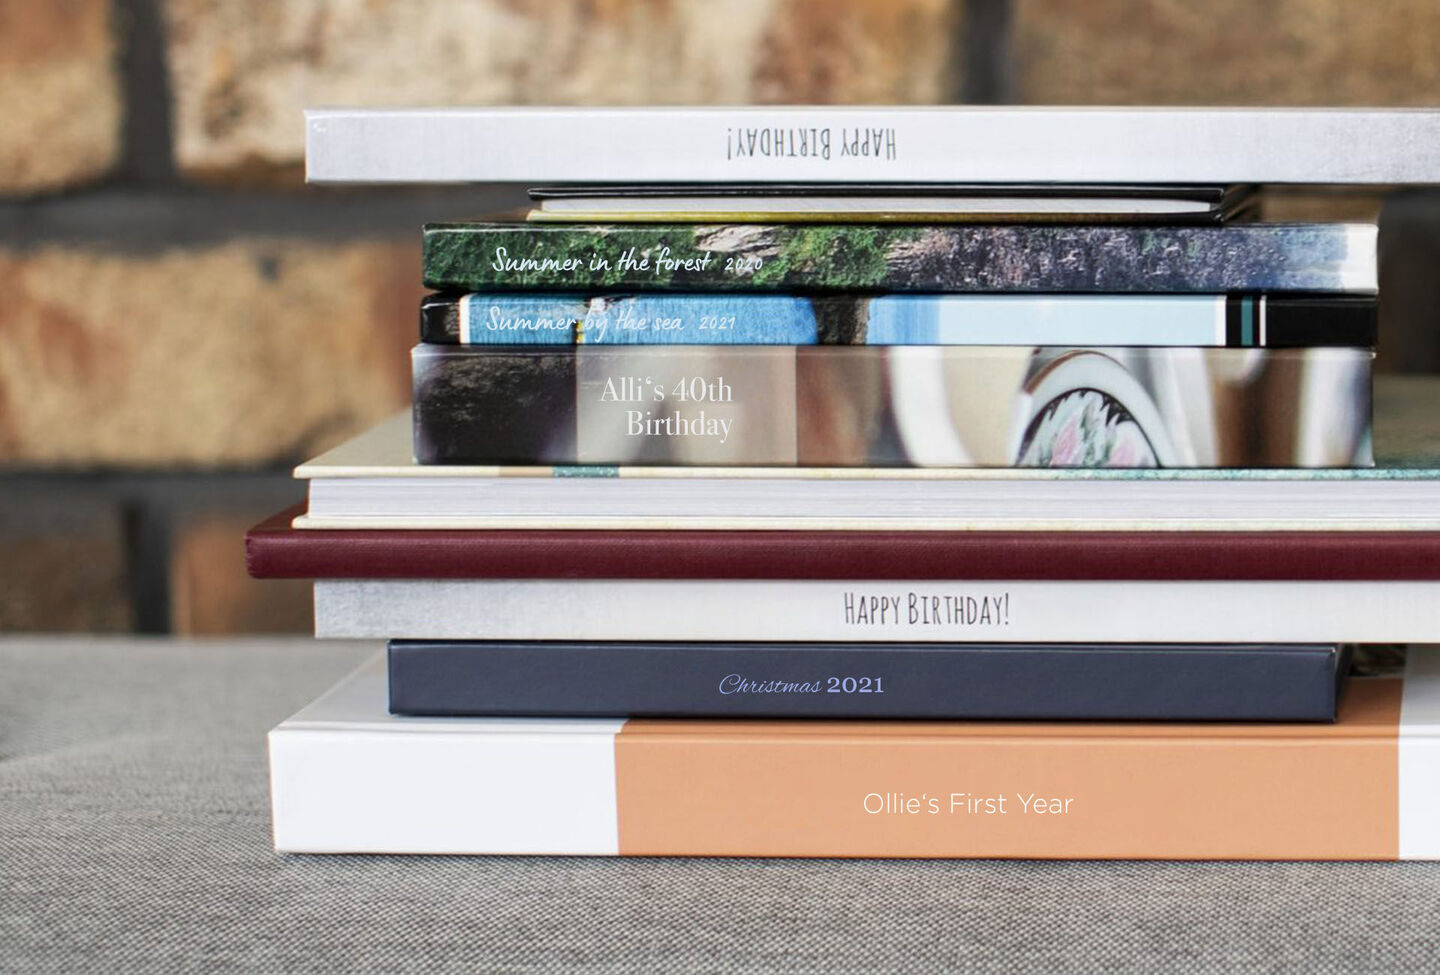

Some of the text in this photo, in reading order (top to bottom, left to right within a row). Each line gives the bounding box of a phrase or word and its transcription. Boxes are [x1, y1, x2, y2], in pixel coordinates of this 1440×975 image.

[727, 128, 896, 160] HAPPY BIRTHDAY!
[492, 246, 763, 276] Summer in the forest 2020
[486, 305, 736, 342] Summer by the sea 2021
[671, 376, 734, 402] 40th
[624, 410, 733, 444] Birthday
[844, 592, 1009, 625] HAPPY BIRTHDAY!
[718, 673, 885, 695] Christmas 2021
[950, 792, 1007, 815] First
[1016, 793, 1075, 815] Year
